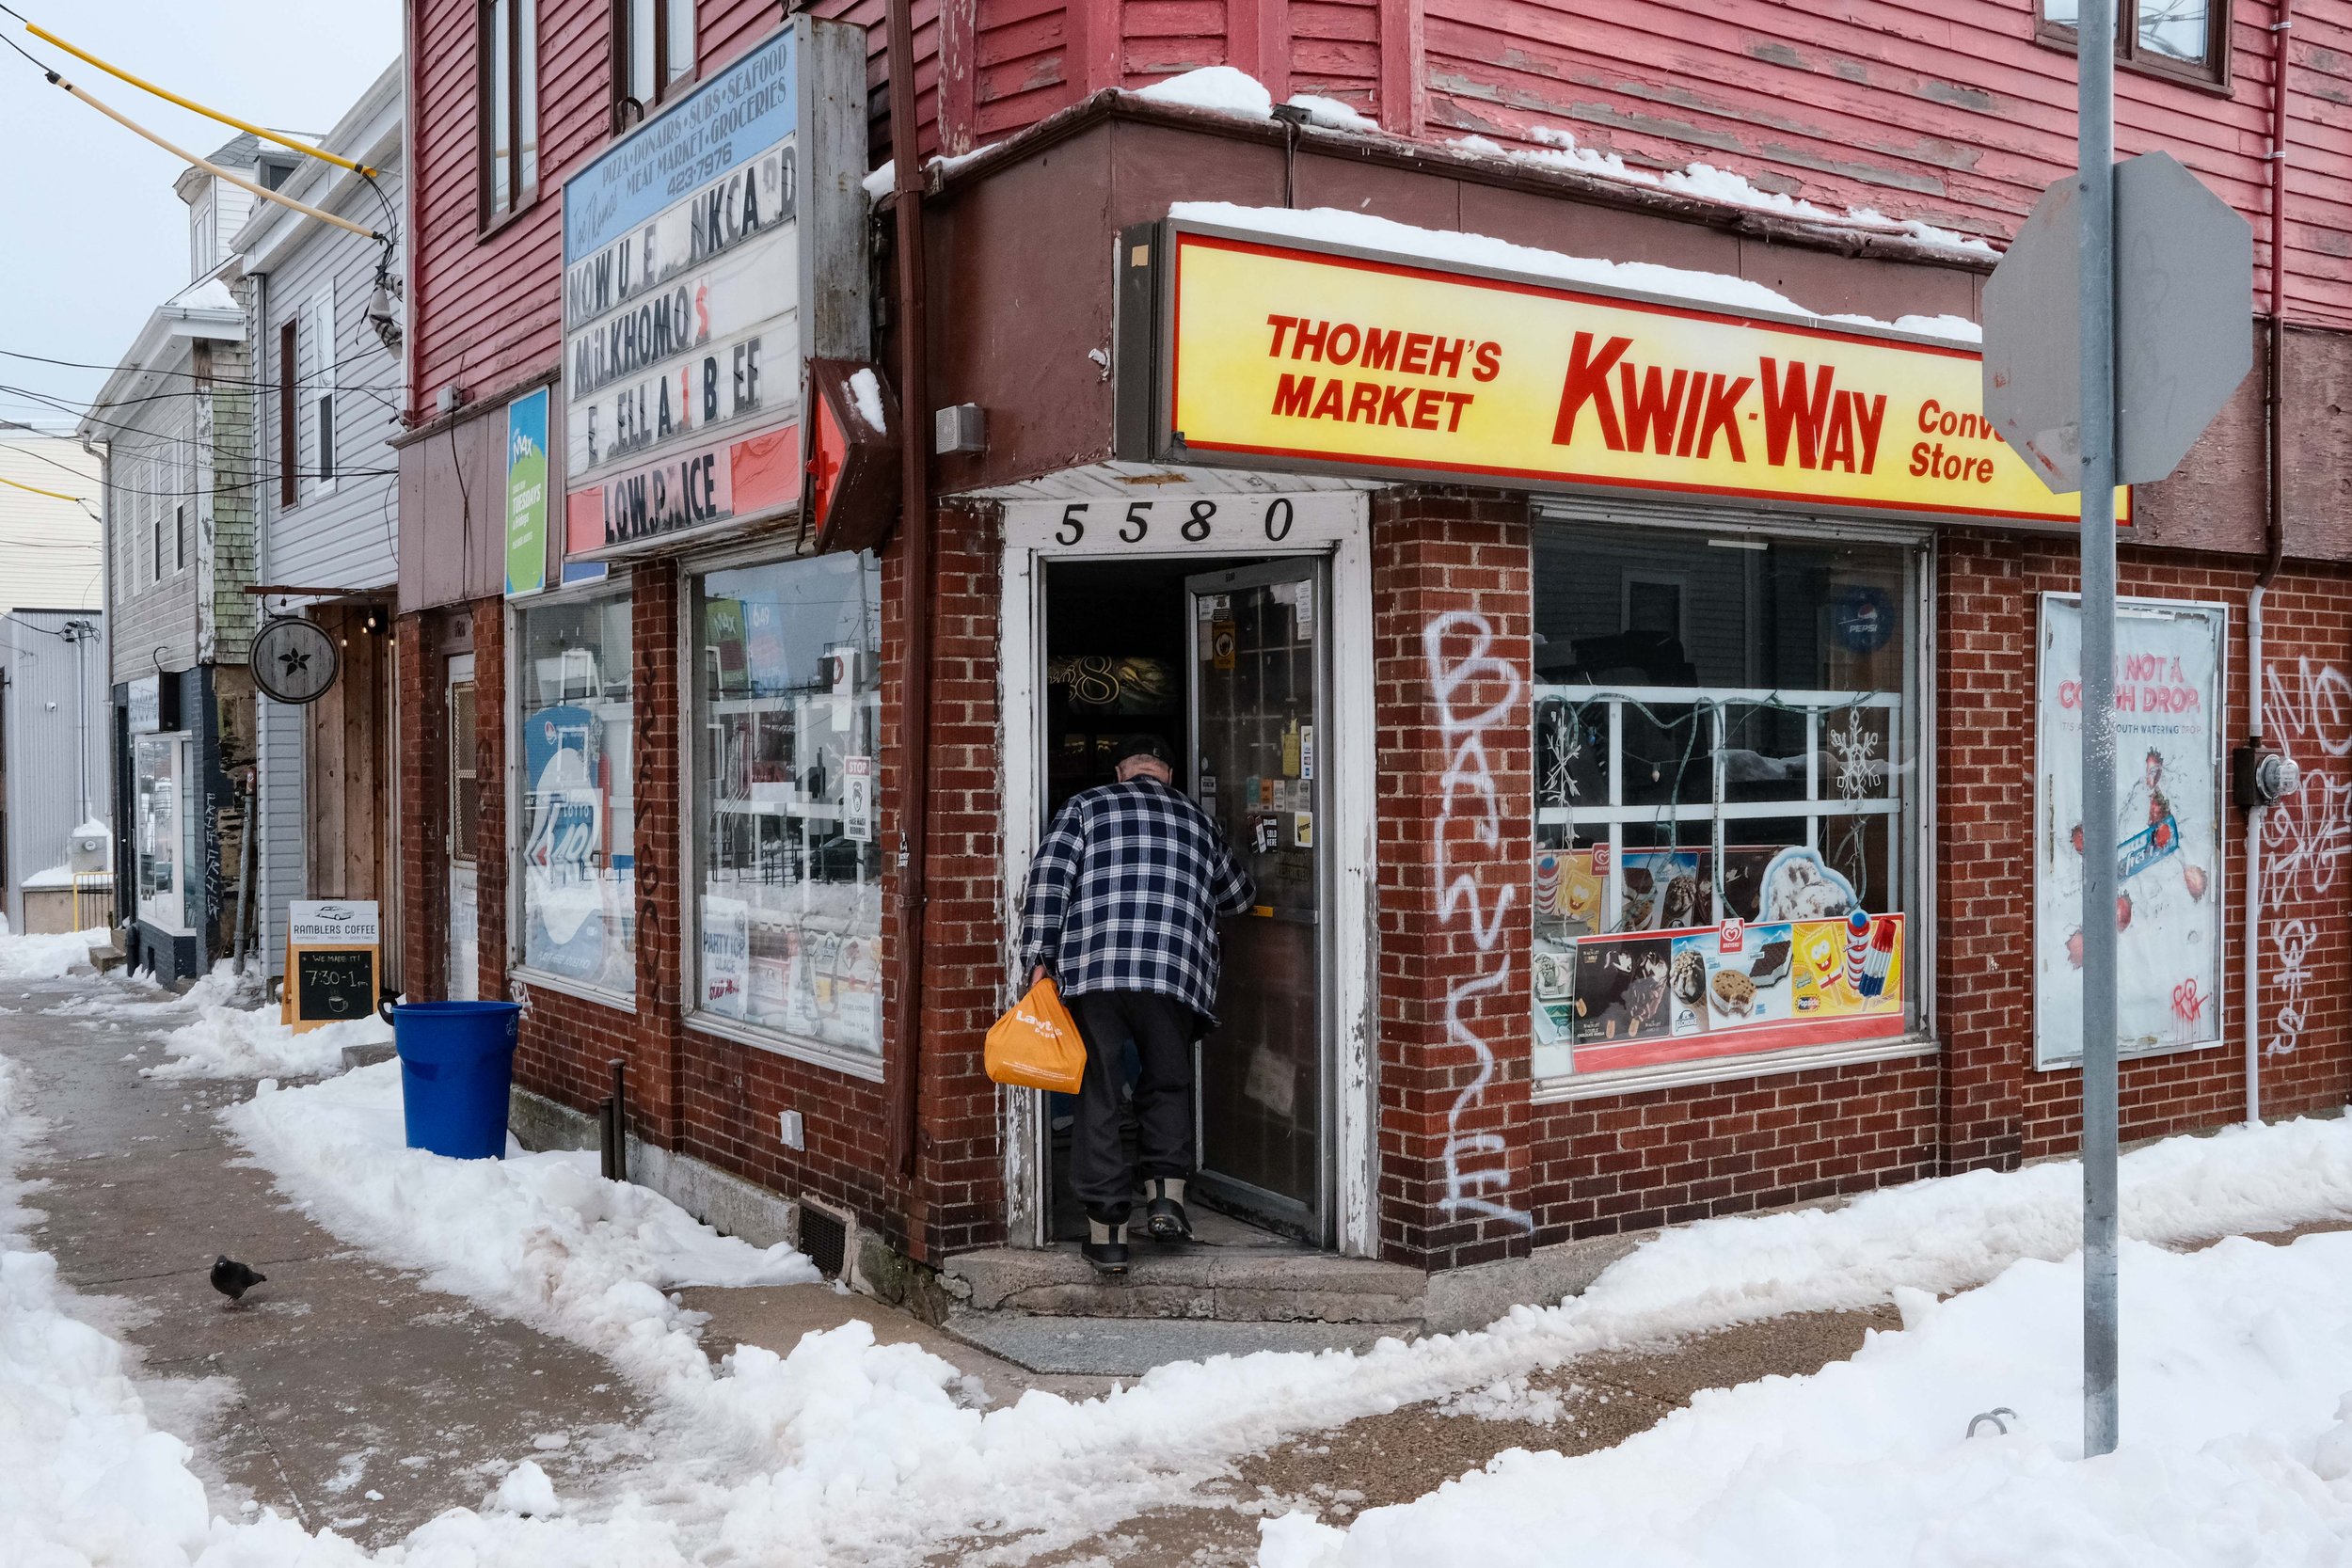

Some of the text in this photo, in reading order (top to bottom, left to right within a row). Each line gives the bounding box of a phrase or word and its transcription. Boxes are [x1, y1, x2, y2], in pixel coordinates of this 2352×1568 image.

[602, 43, 787, 188] PIZZA DONAIRS SUBS SEAFOOD
[627, 76, 787, 198] MEAT MARKET GROCERIES
[1267, 314, 1502, 383] THOMEH'S
[1271, 373, 1474, 433] MARKET
[1909, 441, 1994, 484] Store
[1849, 624, 1878, 633] PEPSI
[2124, 653, 2185, 683] NOT A
[2140, 724, 2180, 735] WATERING
[849, 762, 867, 773] STOP
[294, 925, 375, 935] RAMBLERS COFFEE
[703, 930, 729, 956] PARTY
